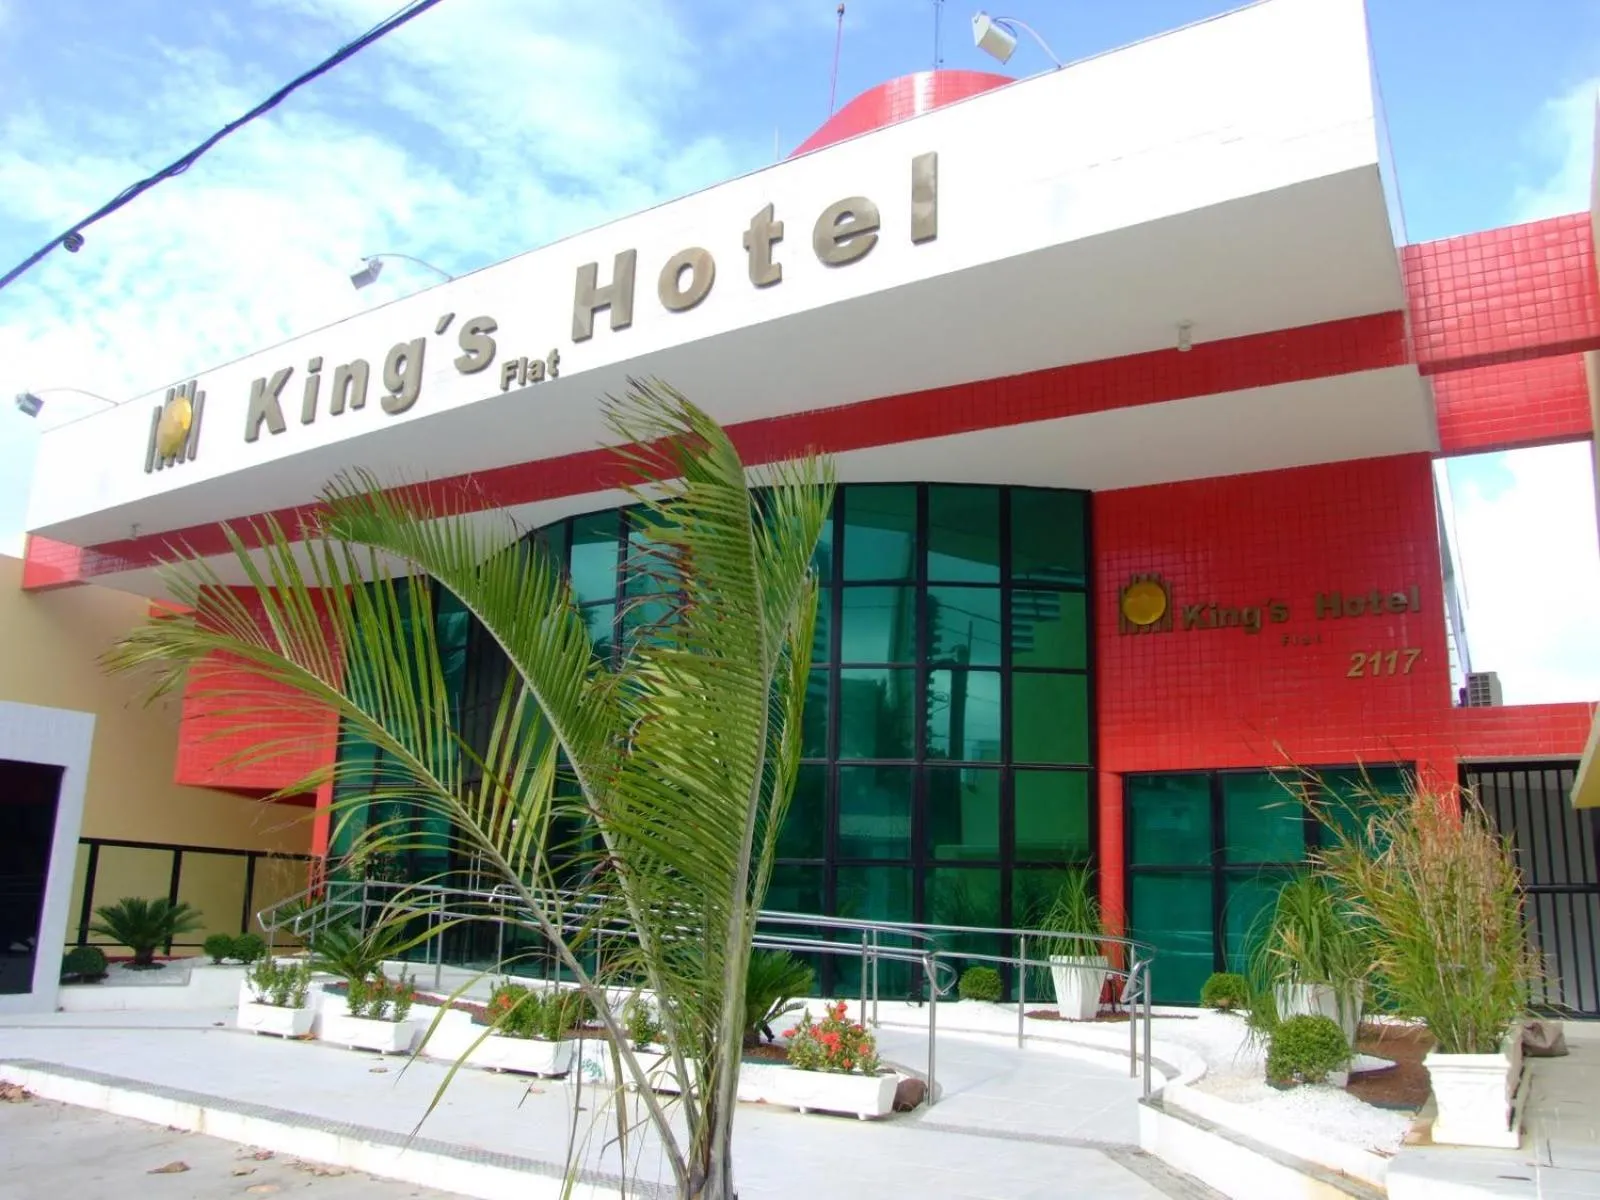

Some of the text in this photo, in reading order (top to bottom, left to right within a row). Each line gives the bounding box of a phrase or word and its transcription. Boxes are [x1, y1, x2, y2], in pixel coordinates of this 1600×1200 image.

[571, 151, 939, 343] Hotel
[499, 347, 560, 391] Flat
[1315, 586, 1420, 619] Hotel
[1347, 648, 1422, 679] 2117
